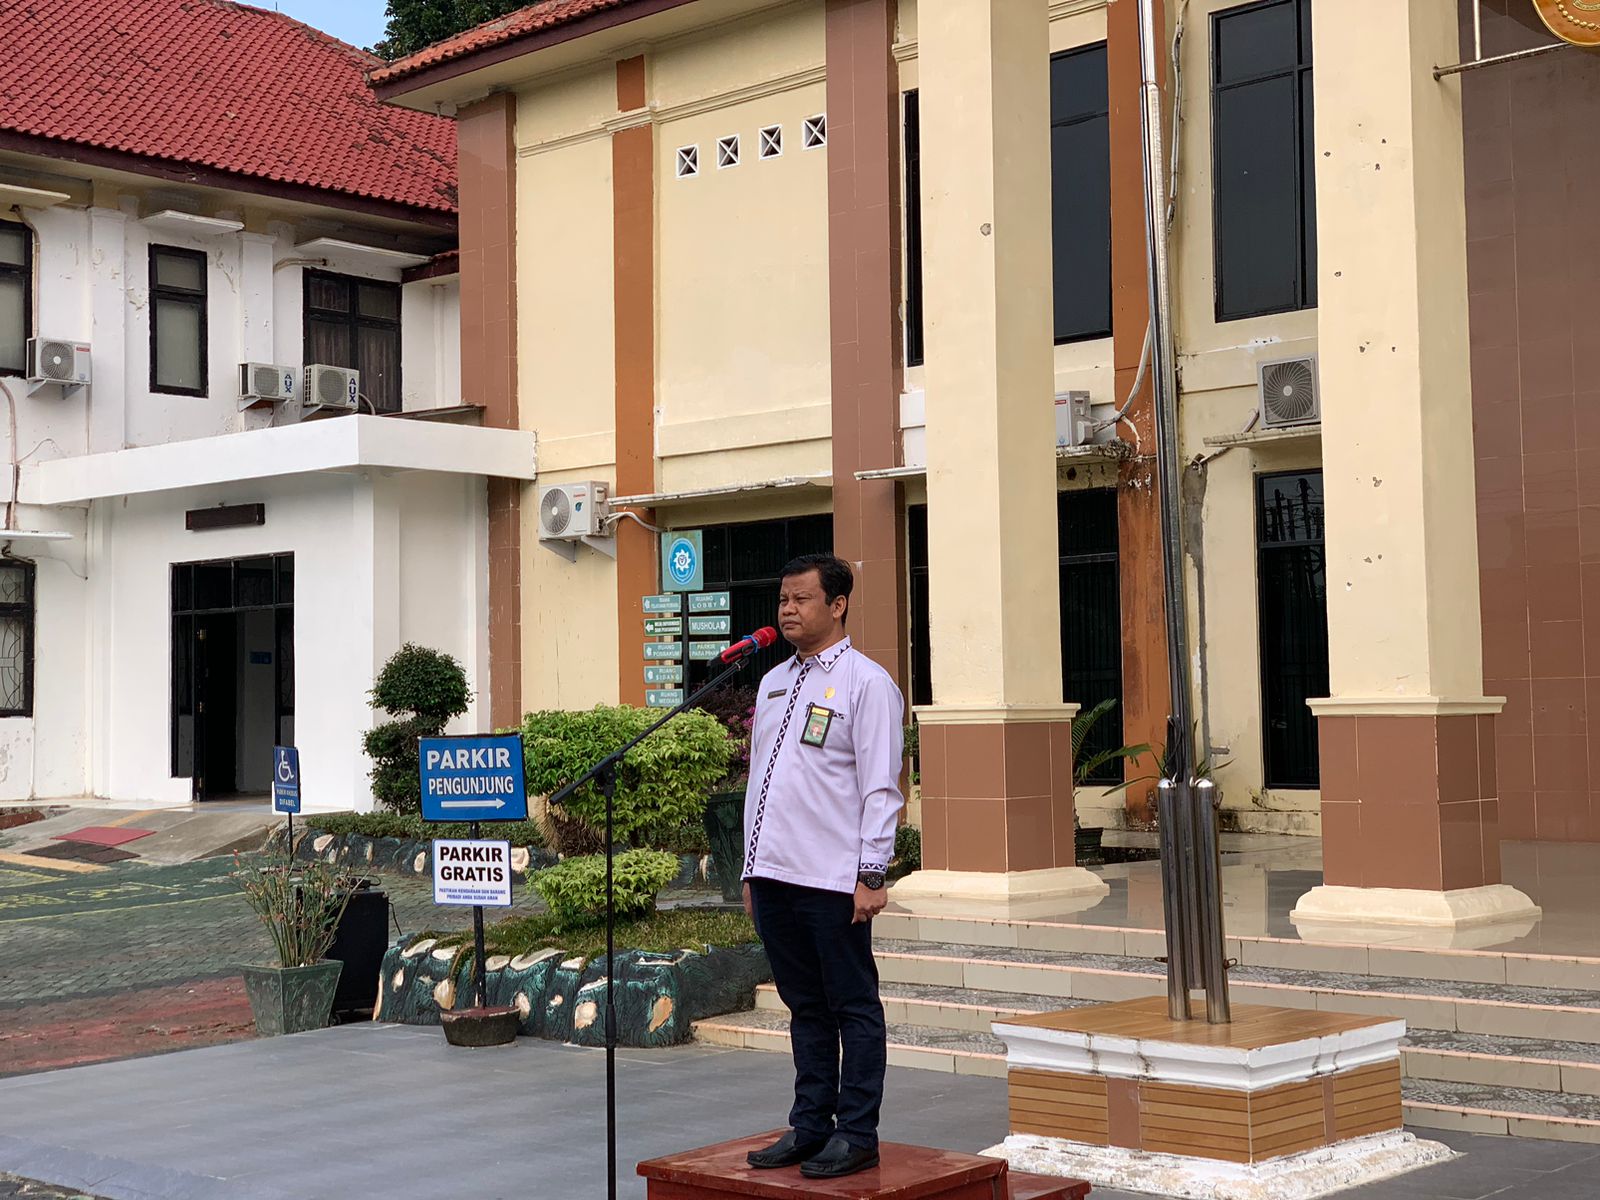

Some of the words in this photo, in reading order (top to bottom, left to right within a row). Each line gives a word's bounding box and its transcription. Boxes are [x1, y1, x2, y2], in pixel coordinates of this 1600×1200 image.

[692, 622, 720, 630] MUSHOLA
[427, 748, 510, 770] PARKIR
[428, 776, 514, 795] PENGUNJUNG
[440, 846, 503, 862] PARKIR
[440, 866, 503, 882] GRATIS
